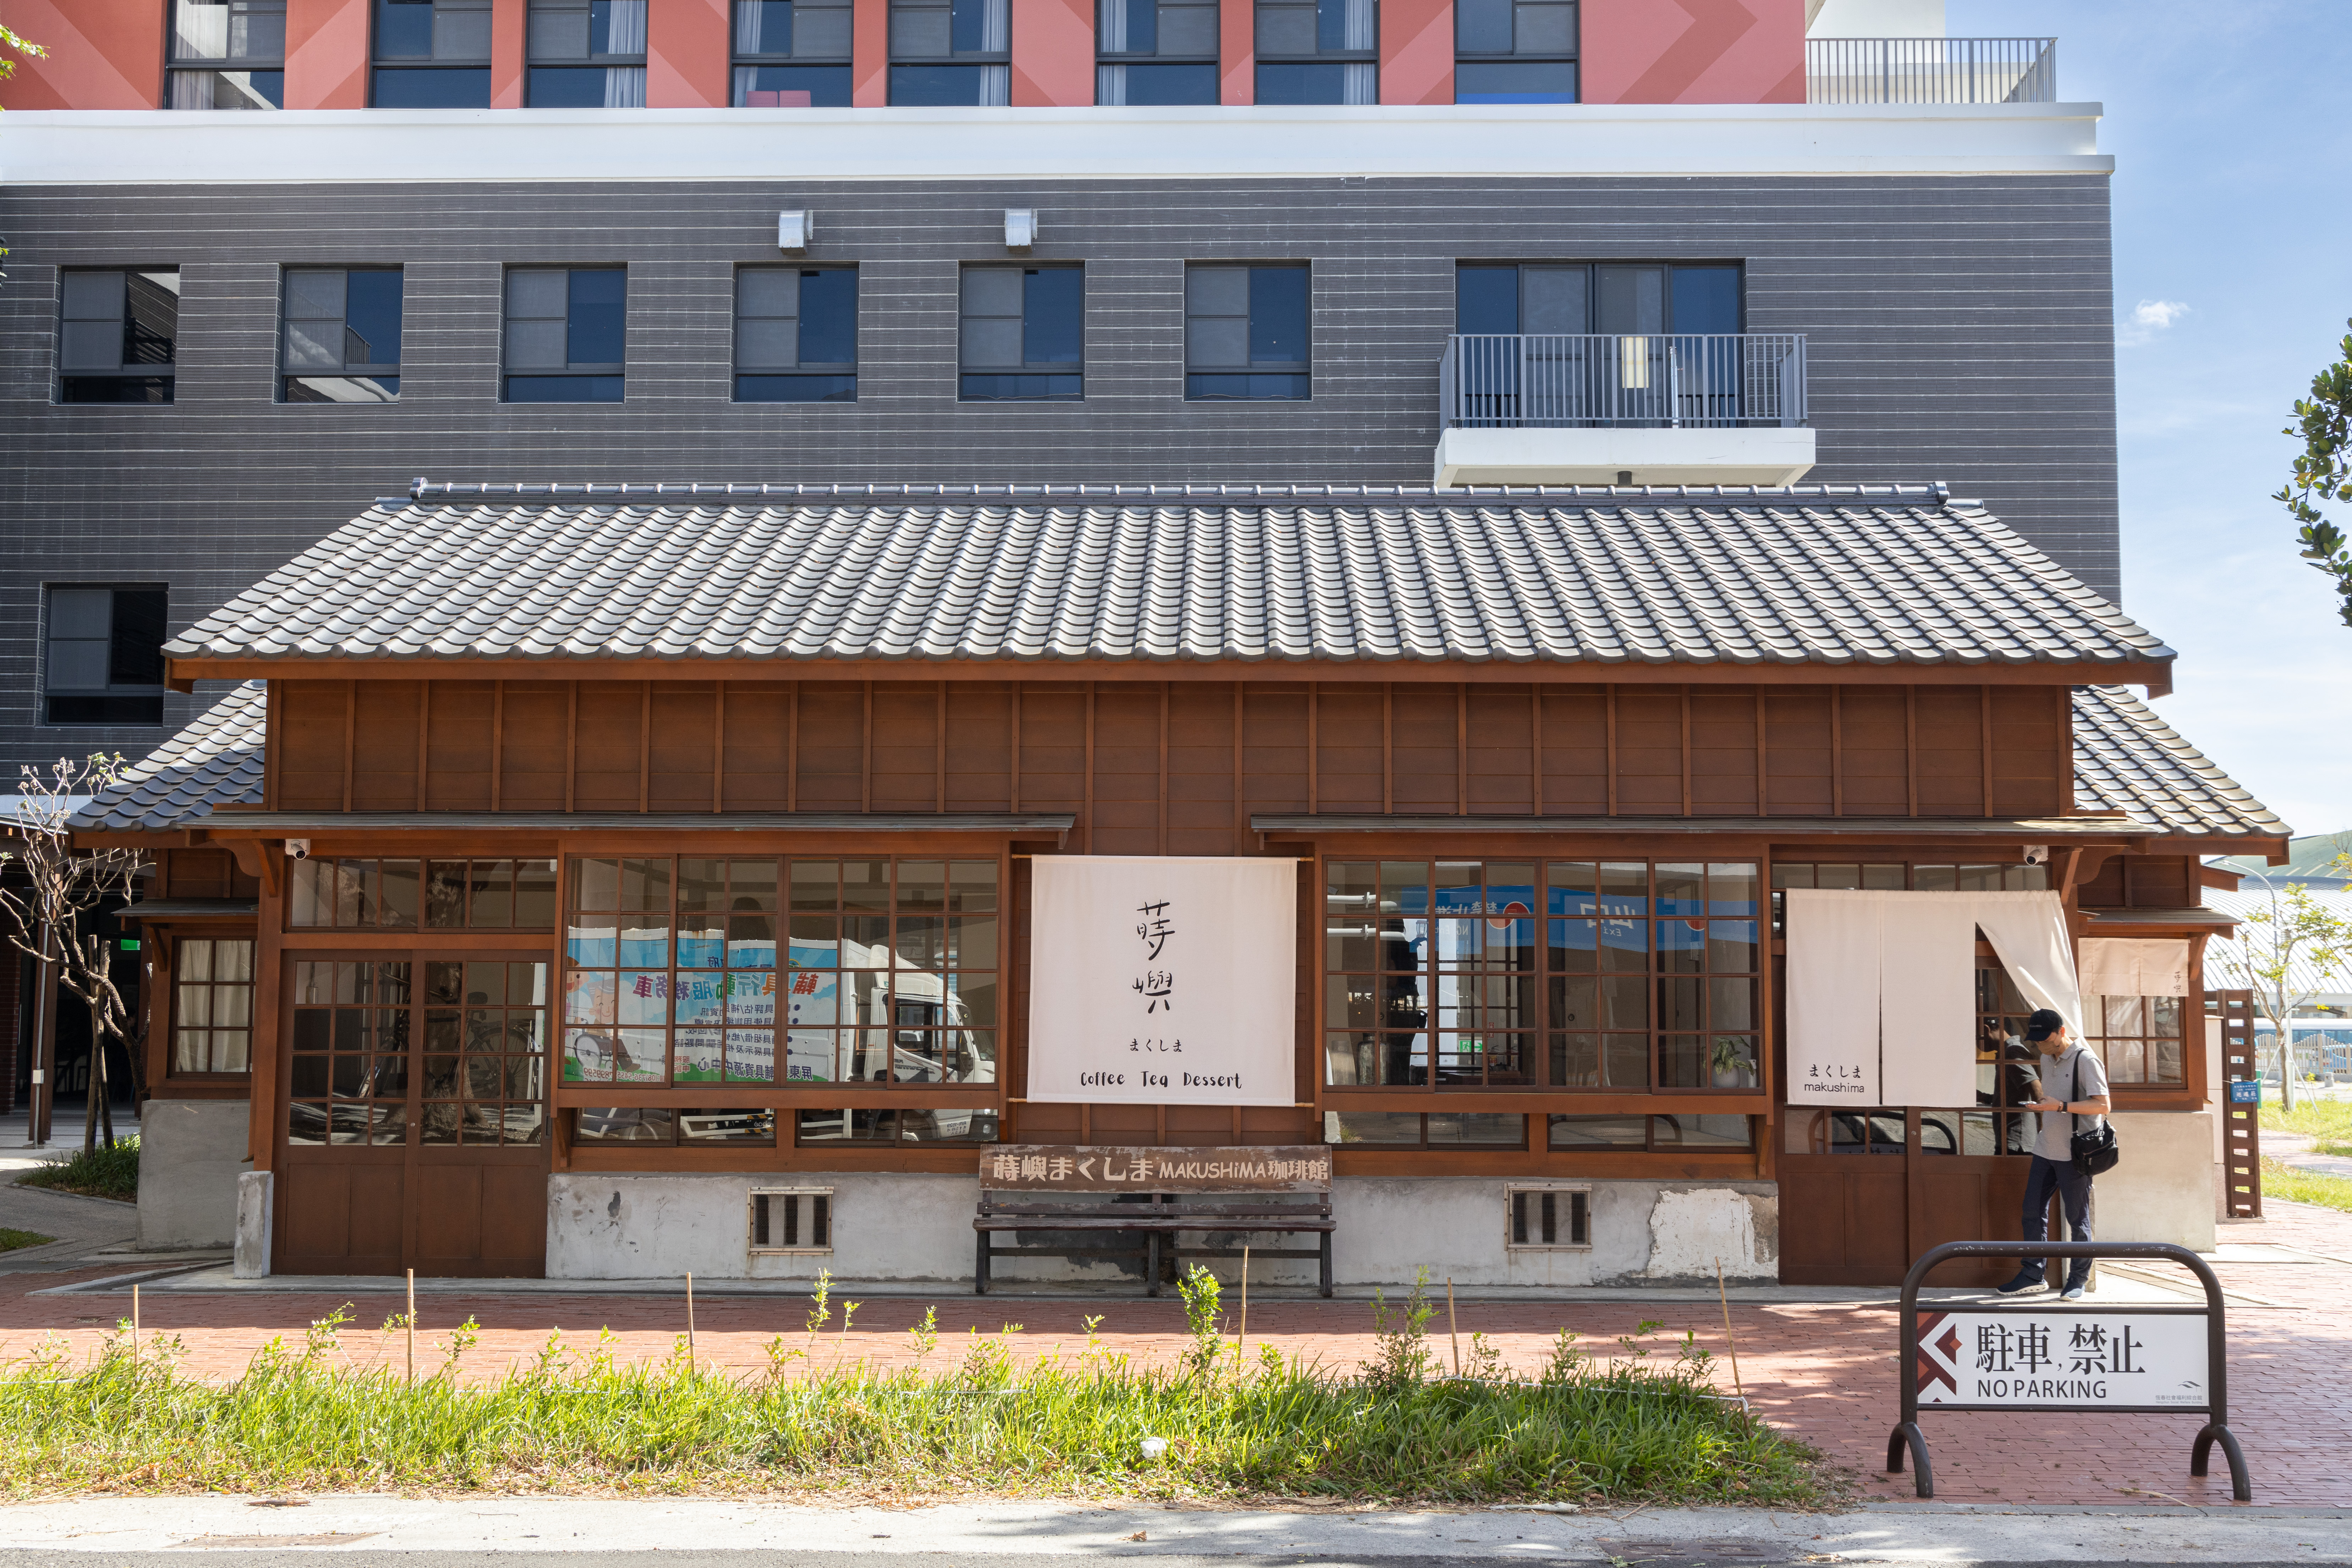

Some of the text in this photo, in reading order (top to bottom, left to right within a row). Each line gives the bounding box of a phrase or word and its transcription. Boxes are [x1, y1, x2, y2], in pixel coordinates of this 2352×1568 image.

[1130, 1038, 1182, 1052] まくしま
[1809, 1064, 1861, 1078] まくしま
[1080, 1071, 1242, 1089] Coffee Tea Dessert
[1804, 1082, 1864, 1093] makushima
[1267, 1159, 1328, 1180] 珈琲館
[1978, 1380, 2106, 1398] NO PARKING
